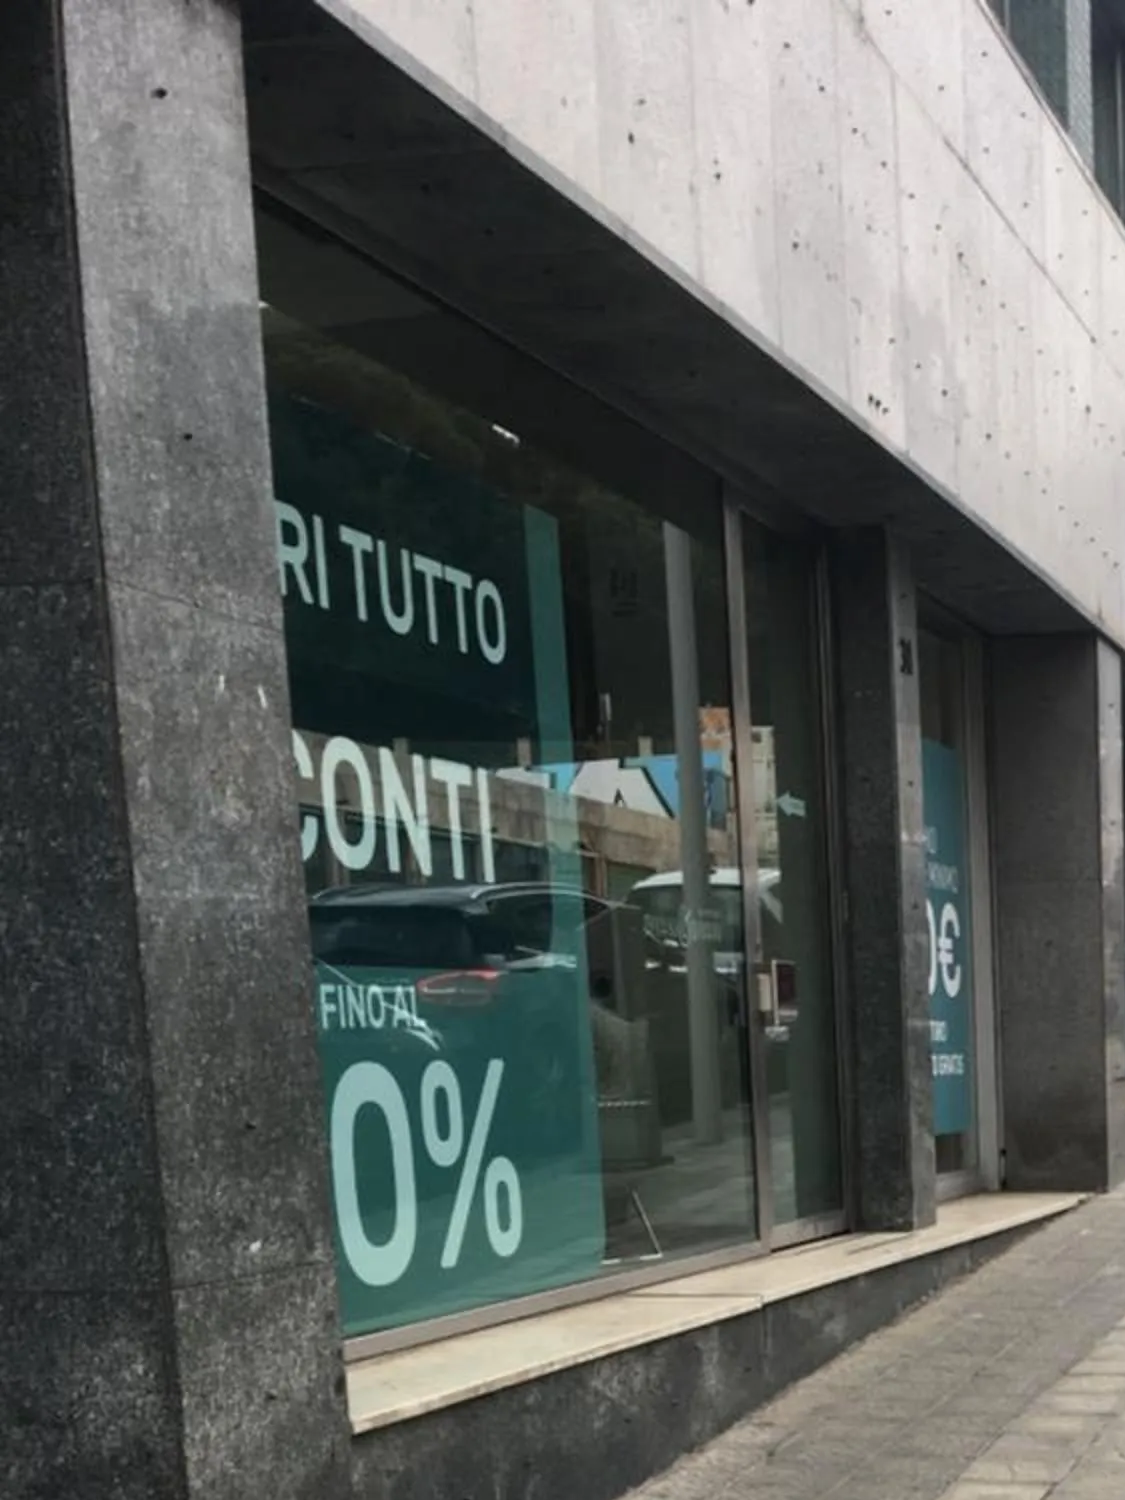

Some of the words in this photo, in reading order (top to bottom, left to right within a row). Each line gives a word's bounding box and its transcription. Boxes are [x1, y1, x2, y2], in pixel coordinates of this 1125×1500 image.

[276, 499, 330, 610] RI
[338, 524, 507, 665] TUTTO
[319, 984, 383, 1029] FINO
[392, 984, 420, 1029] AL
